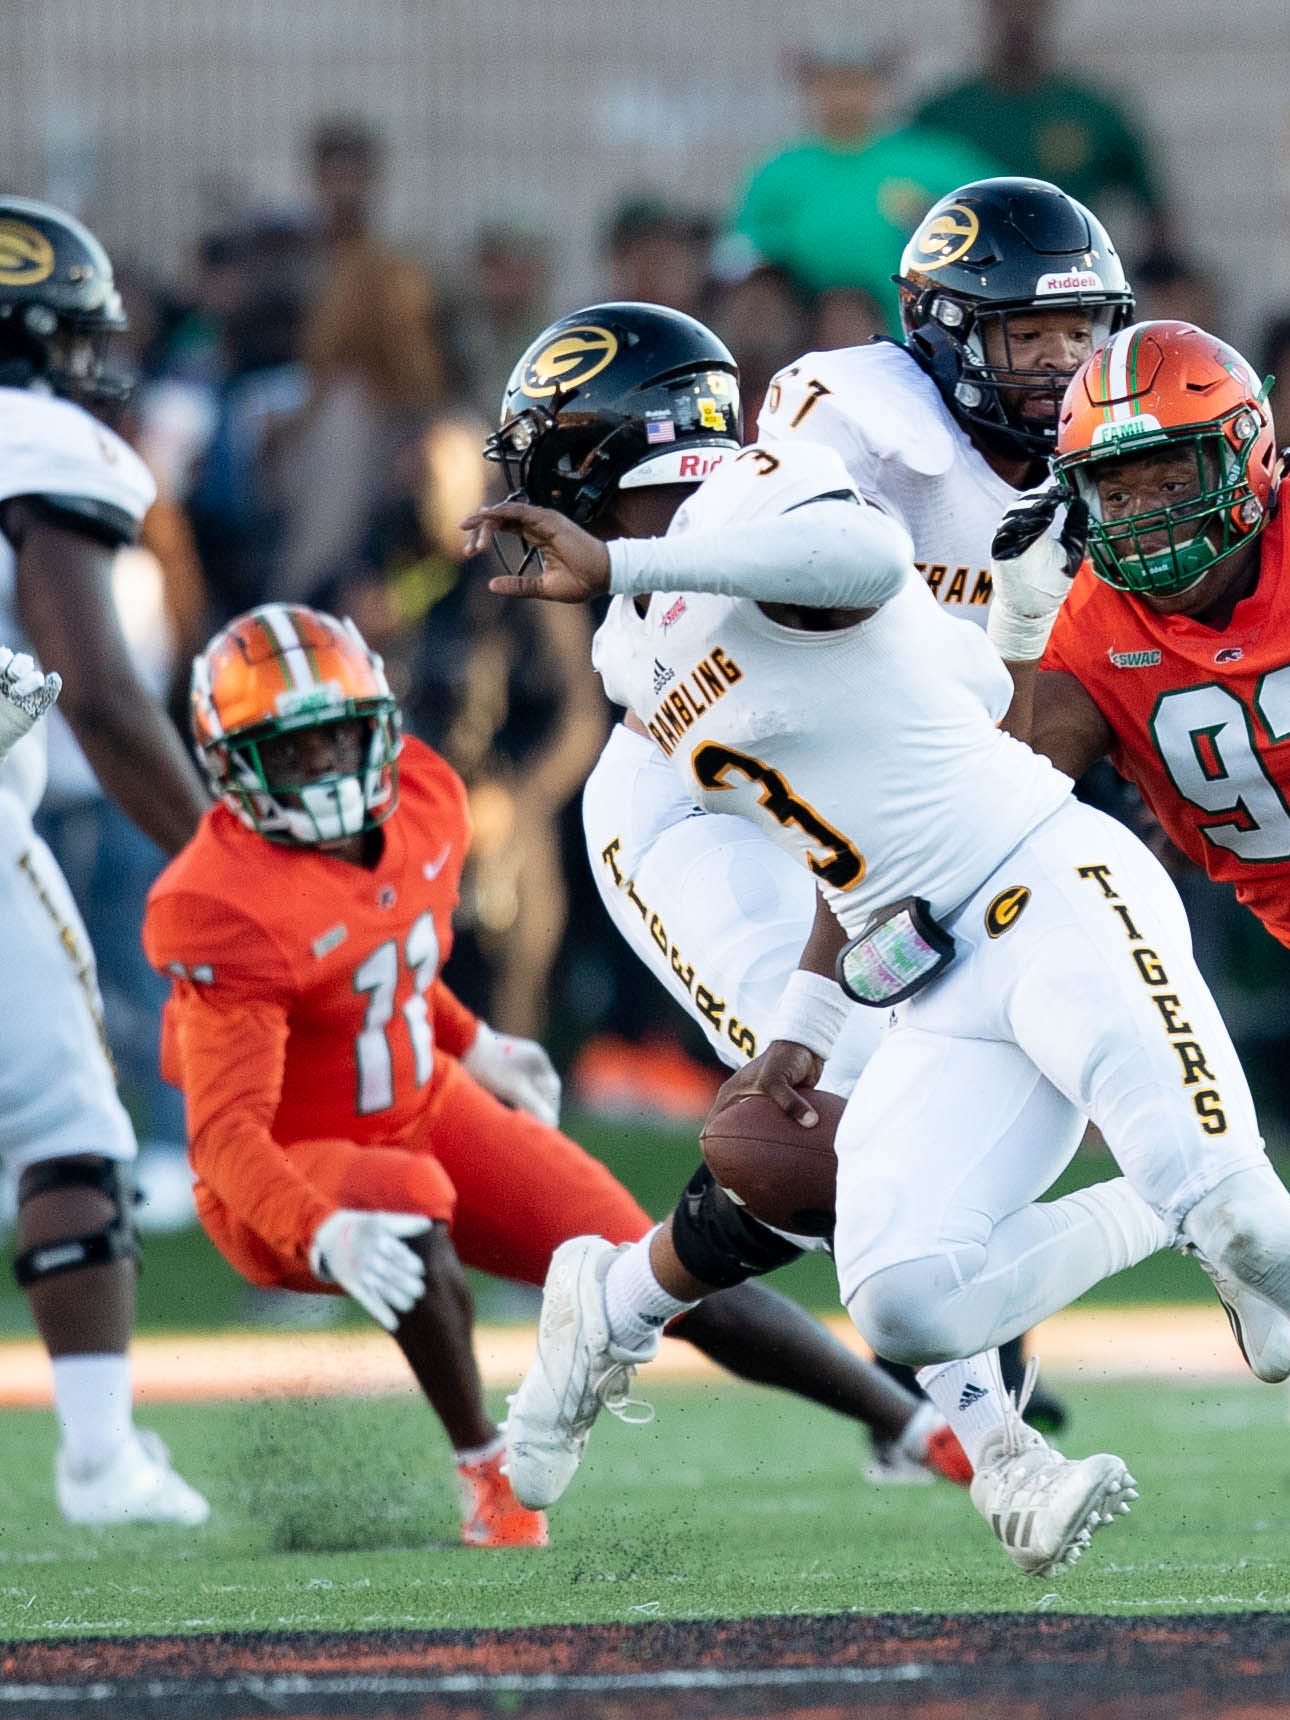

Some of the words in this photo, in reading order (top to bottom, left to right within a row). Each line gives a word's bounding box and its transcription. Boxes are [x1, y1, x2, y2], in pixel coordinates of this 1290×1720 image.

[1118, 651, 1162, 667] SWAC
[691, 738, 868, 893] 3
[601, 835, 758, 1060] TIGERS
[1074, 863, 1228, 1137] TIGERS
